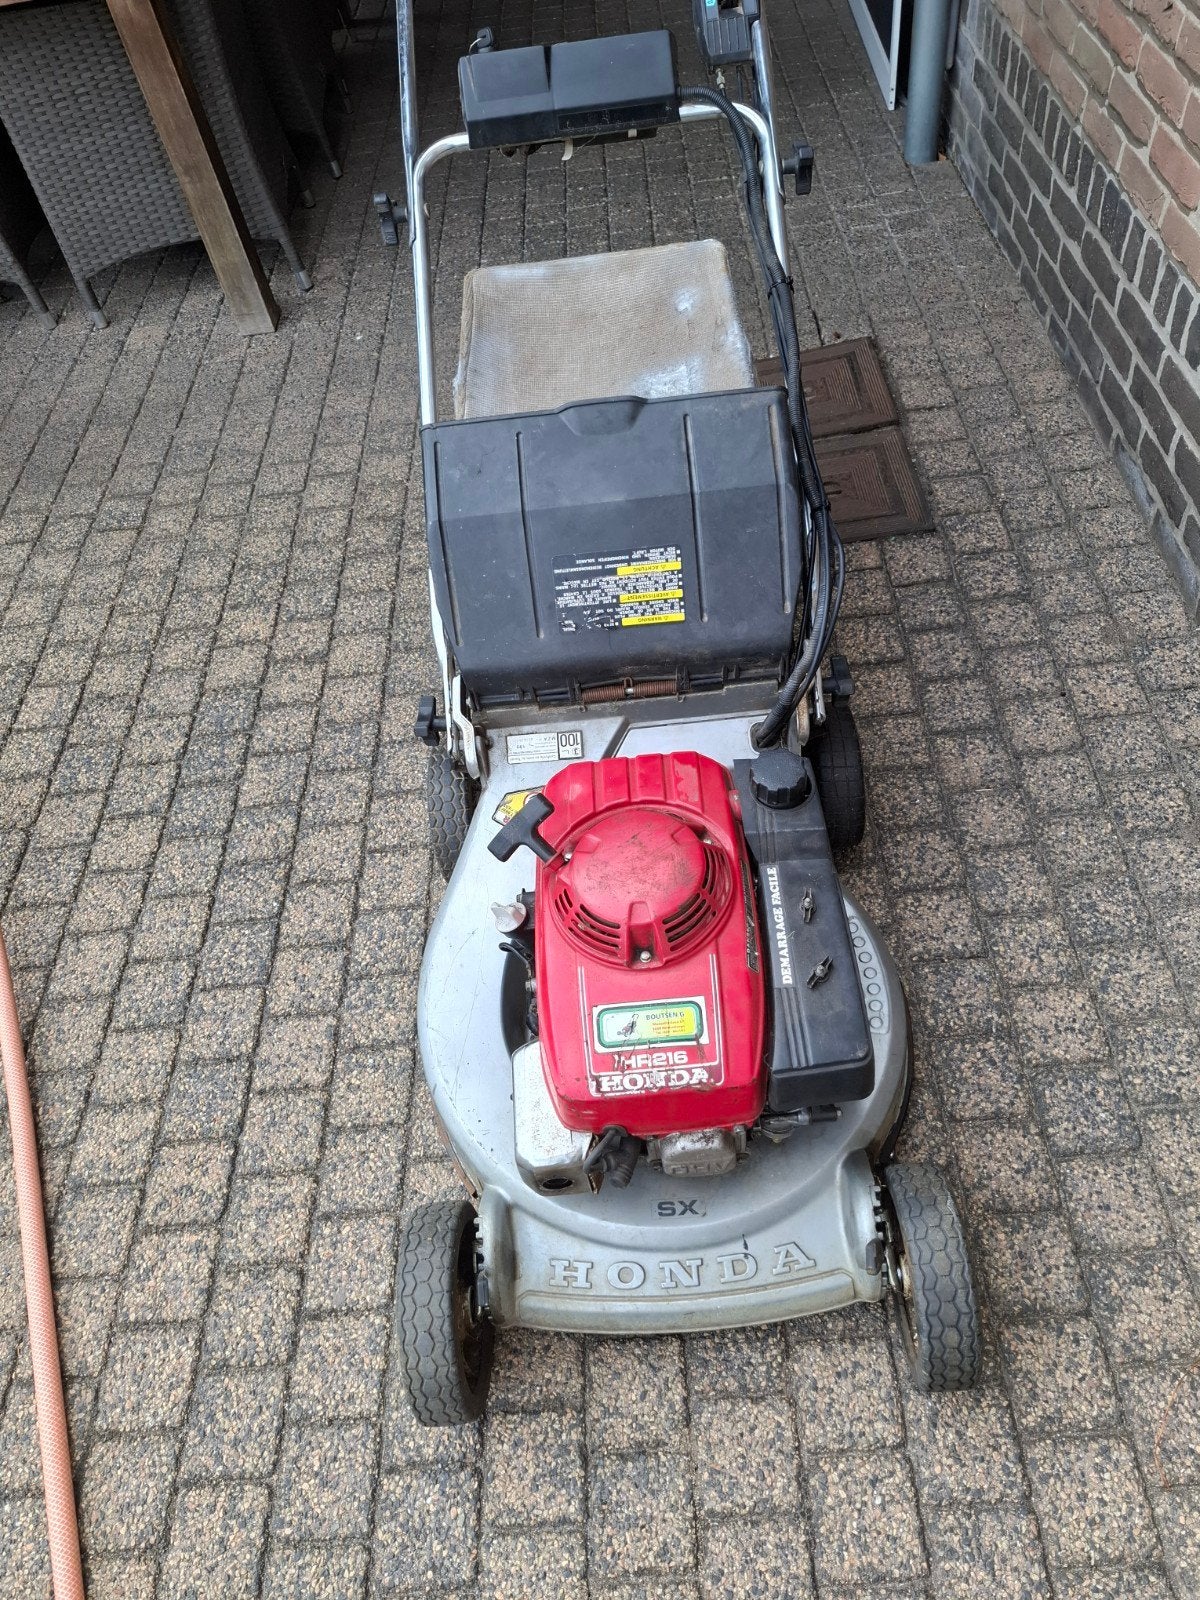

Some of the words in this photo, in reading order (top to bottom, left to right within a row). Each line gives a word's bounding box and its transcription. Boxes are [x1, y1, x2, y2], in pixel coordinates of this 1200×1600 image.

[627, 592, 669, 600] AVERTISSEMENT
[560, 733, 580, 747] 100
[767, 867, 782, 906] FACILE
[773, 907, 793, 985] DEMARRAGE
[646, 1011, 678, 1021] BOUTSEN
[599, 1067, 709, 1092] HONDA
[657, 1200, 699, 1216] SX
[549, 1241, 816, 1290] HONDA
